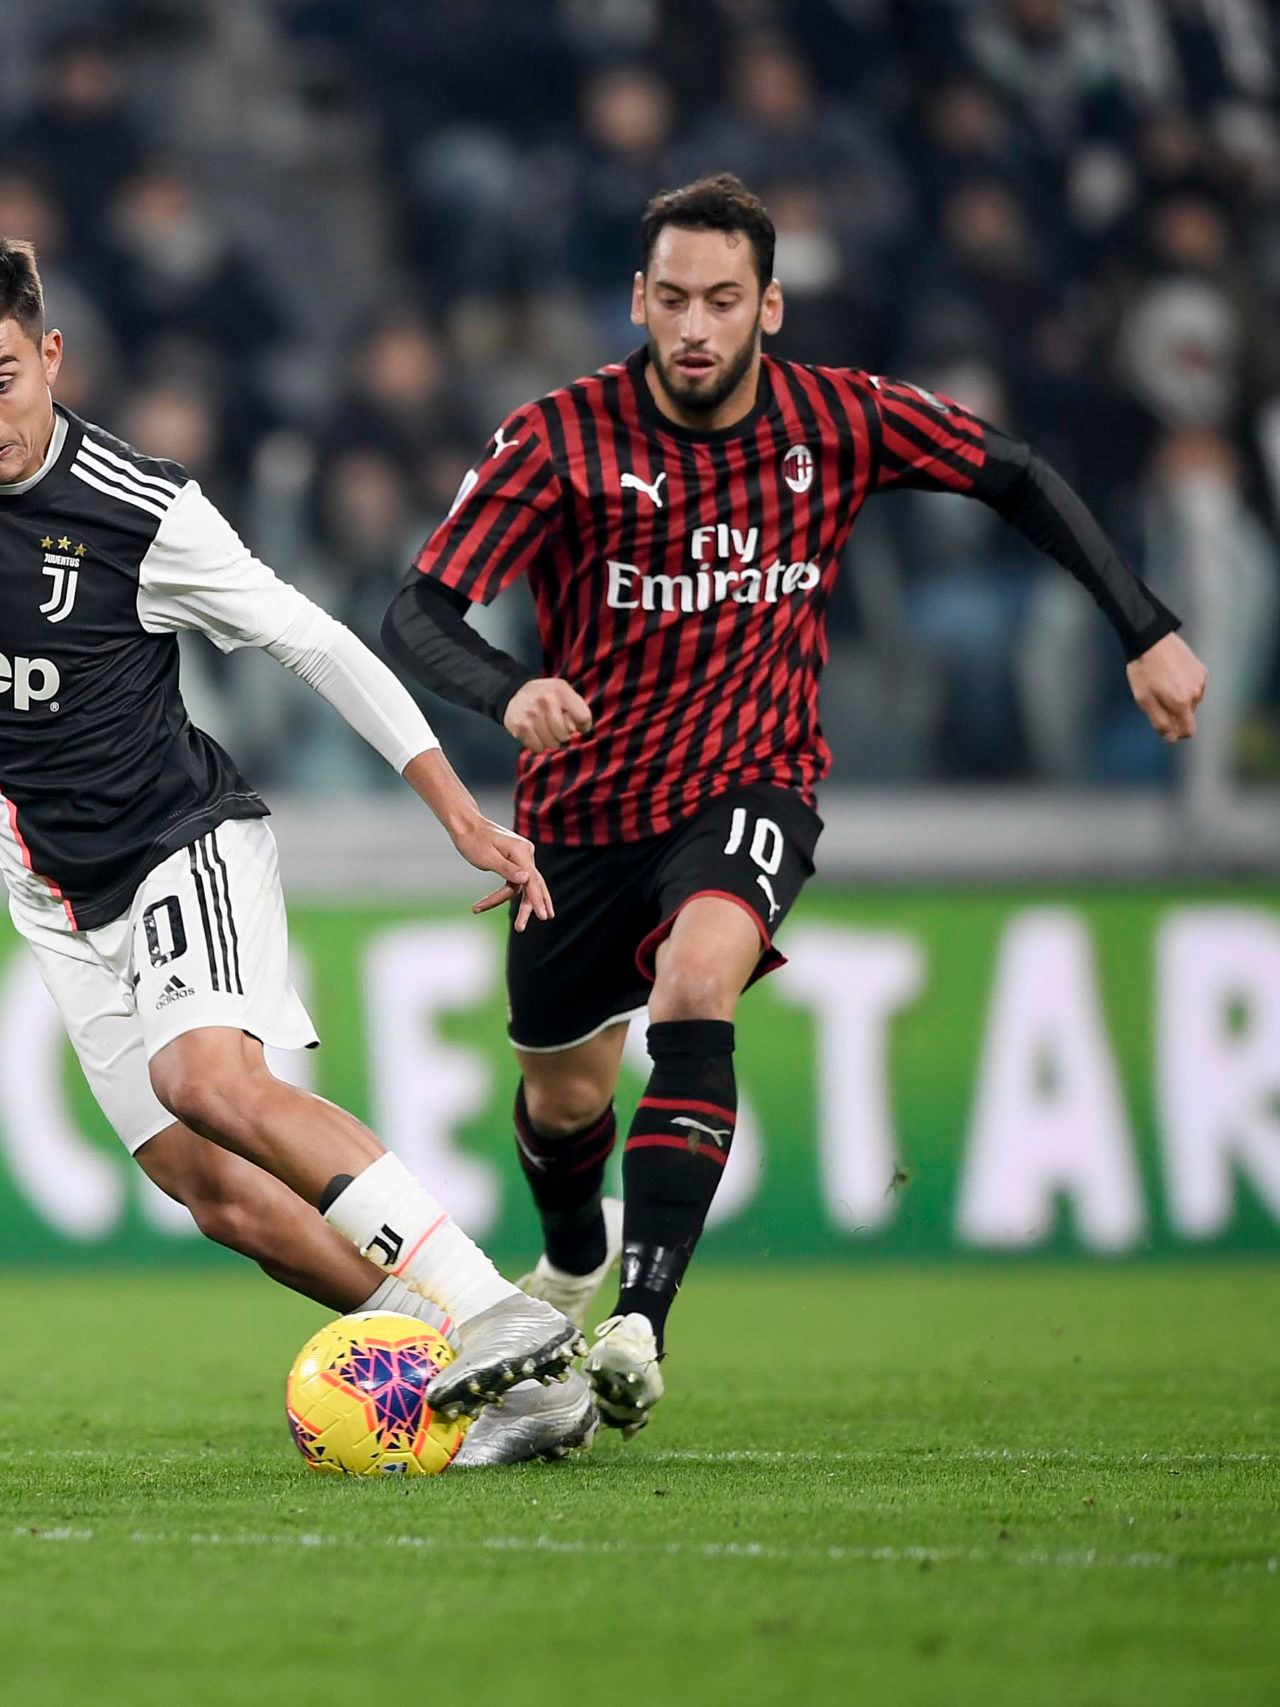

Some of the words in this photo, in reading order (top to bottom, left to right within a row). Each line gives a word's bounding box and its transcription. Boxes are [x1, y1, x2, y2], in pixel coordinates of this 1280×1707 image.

[44, 553, 80, 567] JUVENTUS
[691, 523, 758, 562] Fly
[606, 558, 820, 613] Emirates
[723, 807, 784, 875] 10
[155, 986, 196, 1010] adidas
